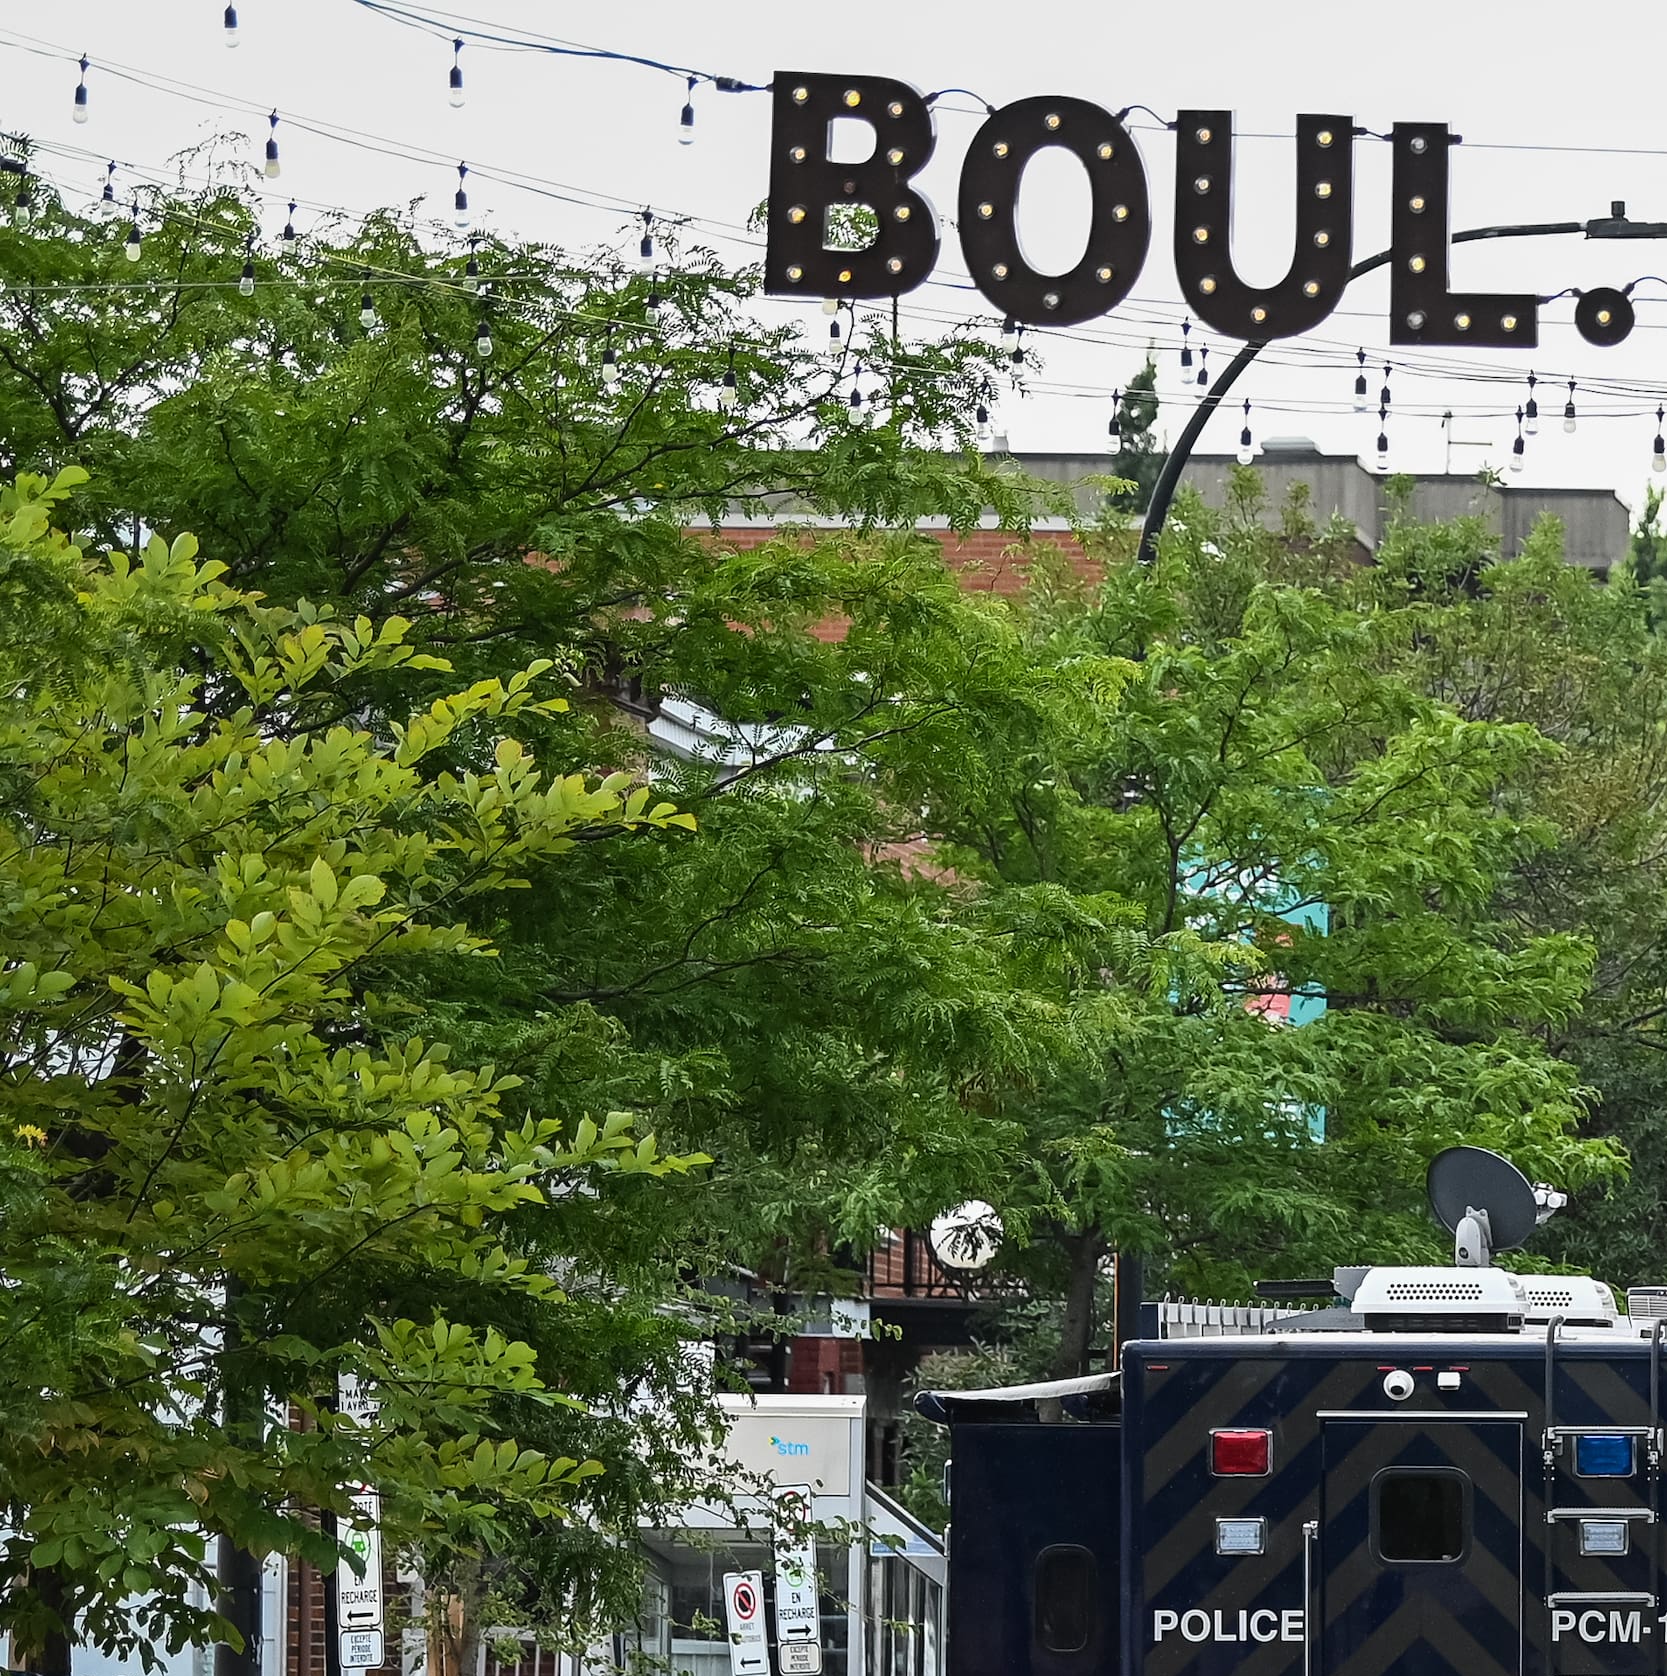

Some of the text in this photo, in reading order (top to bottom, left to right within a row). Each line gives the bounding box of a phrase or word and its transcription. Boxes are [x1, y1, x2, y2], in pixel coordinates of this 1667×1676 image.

[765, 70, 1635, 348] BOUL.
[778, 1442, 809, 1456] stm
[341, 1590, 378, 1604] RECHARGE
[779, 1607, 816, 1620] RECHARGE
[1154, 1609, 1305, 1643] POLICE
